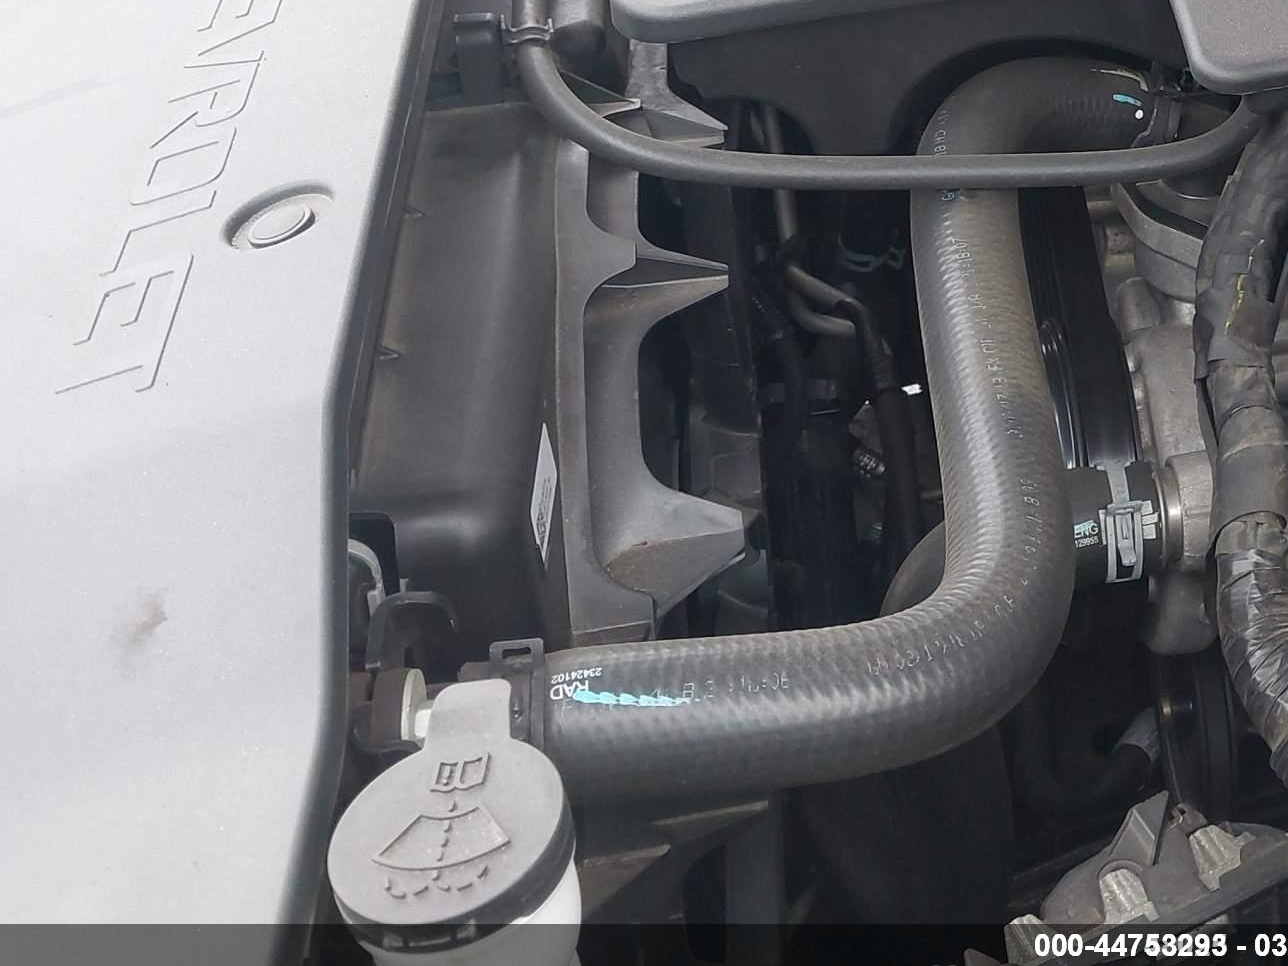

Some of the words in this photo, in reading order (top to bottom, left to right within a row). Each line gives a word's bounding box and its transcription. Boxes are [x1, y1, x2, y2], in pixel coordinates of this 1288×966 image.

[1074, 524, 1099, 538] ENG
[551, 667, 602, 684] 23424102
[550, 680, 590, 699] RAD
